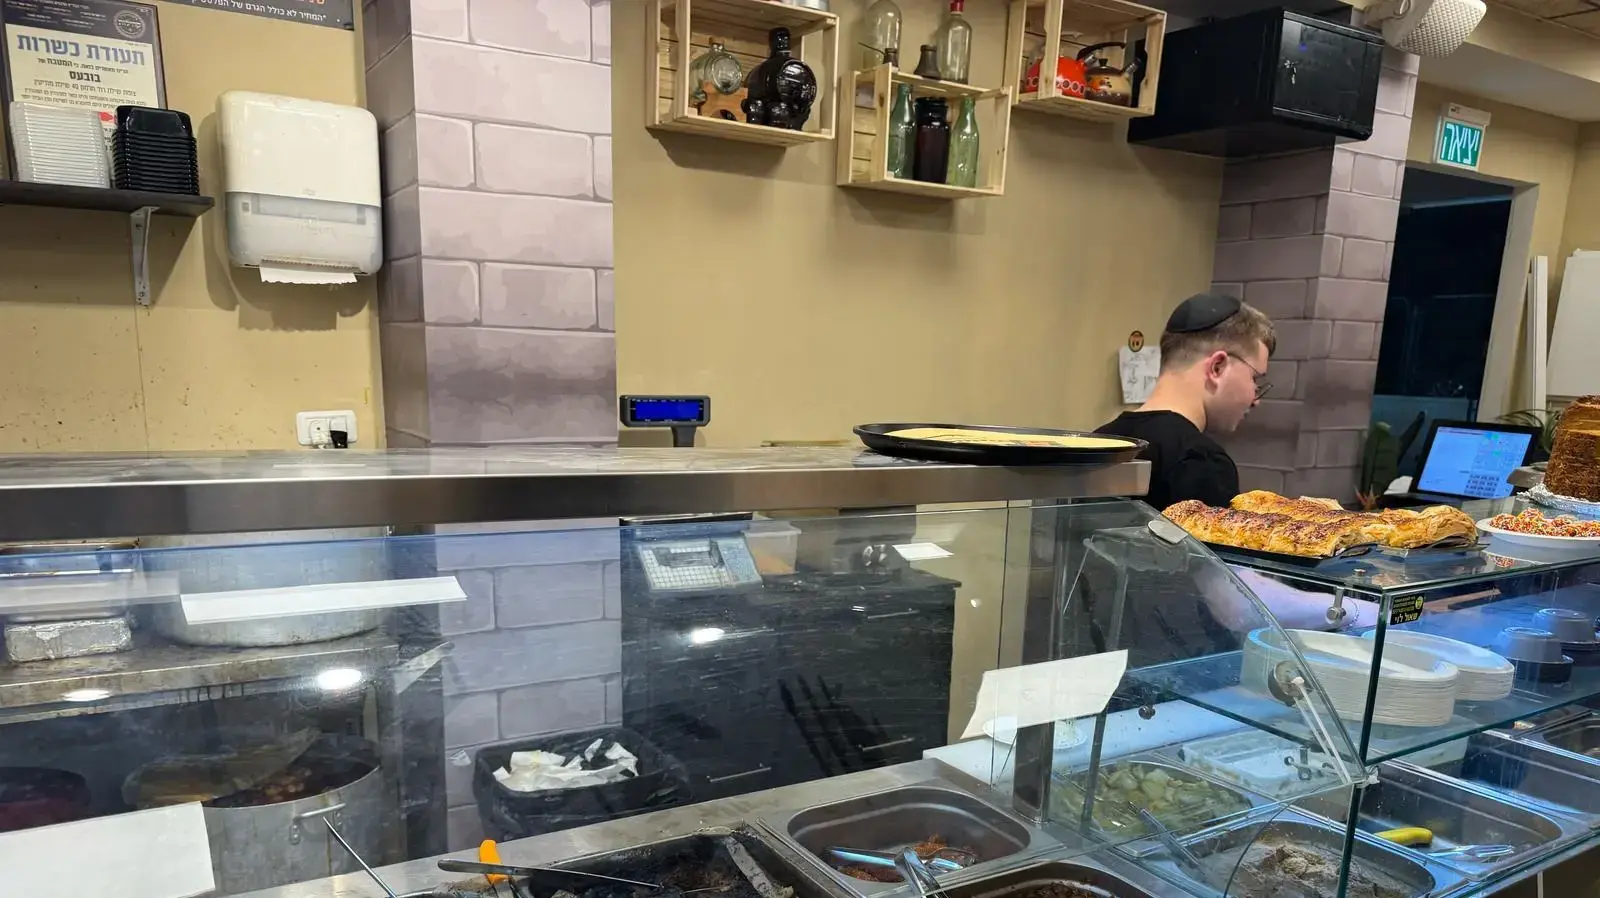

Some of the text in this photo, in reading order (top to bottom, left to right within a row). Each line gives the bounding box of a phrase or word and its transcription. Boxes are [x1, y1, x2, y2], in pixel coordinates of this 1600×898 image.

[231, 0, 243, 9] של
[267, 5, 285, 15] כולל
[286, 9, 297, 17] לא
[17, 34, 145, 66] תעודת כשרות
[47, 57, 73, 67] המטבח
[69, 70, 102, 83] בובעס
[1441, 123, 1480, 165] יציאה
